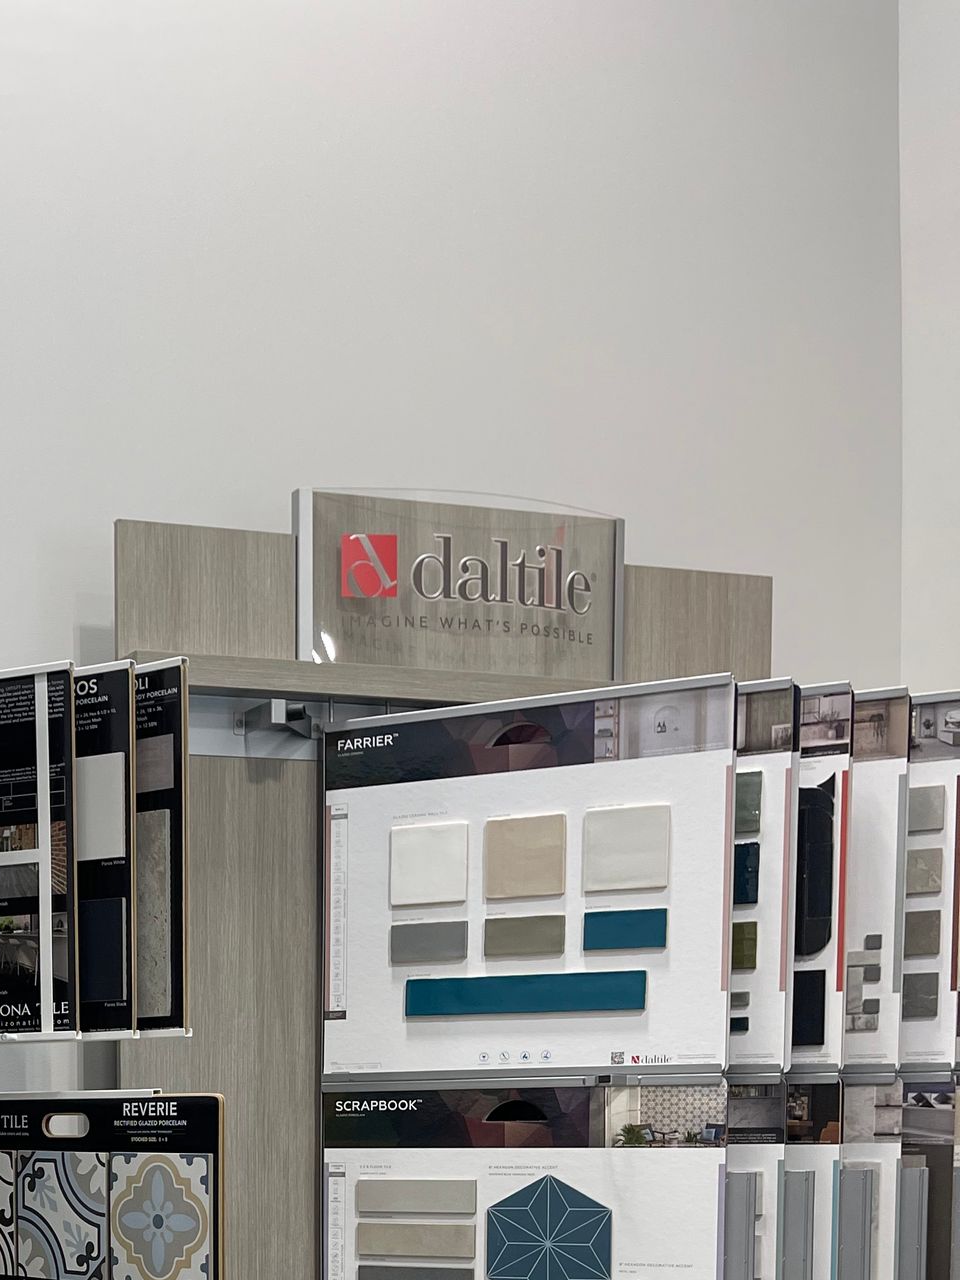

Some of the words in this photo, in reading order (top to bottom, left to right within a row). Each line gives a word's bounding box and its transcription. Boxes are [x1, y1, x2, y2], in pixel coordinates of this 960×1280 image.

[411, 533, 592, 616] daltile
[342, 614, 428, 630] IMAGINE
[440, 615, 511, 633] WHAT'S
[520, 621, 593, 645] POSSIBLE
[146, 687, 178, 699] PORCELAIN
[122, 1101, 178, 1117] REVERIE
[0, 1114, 29, 1129] TILE
